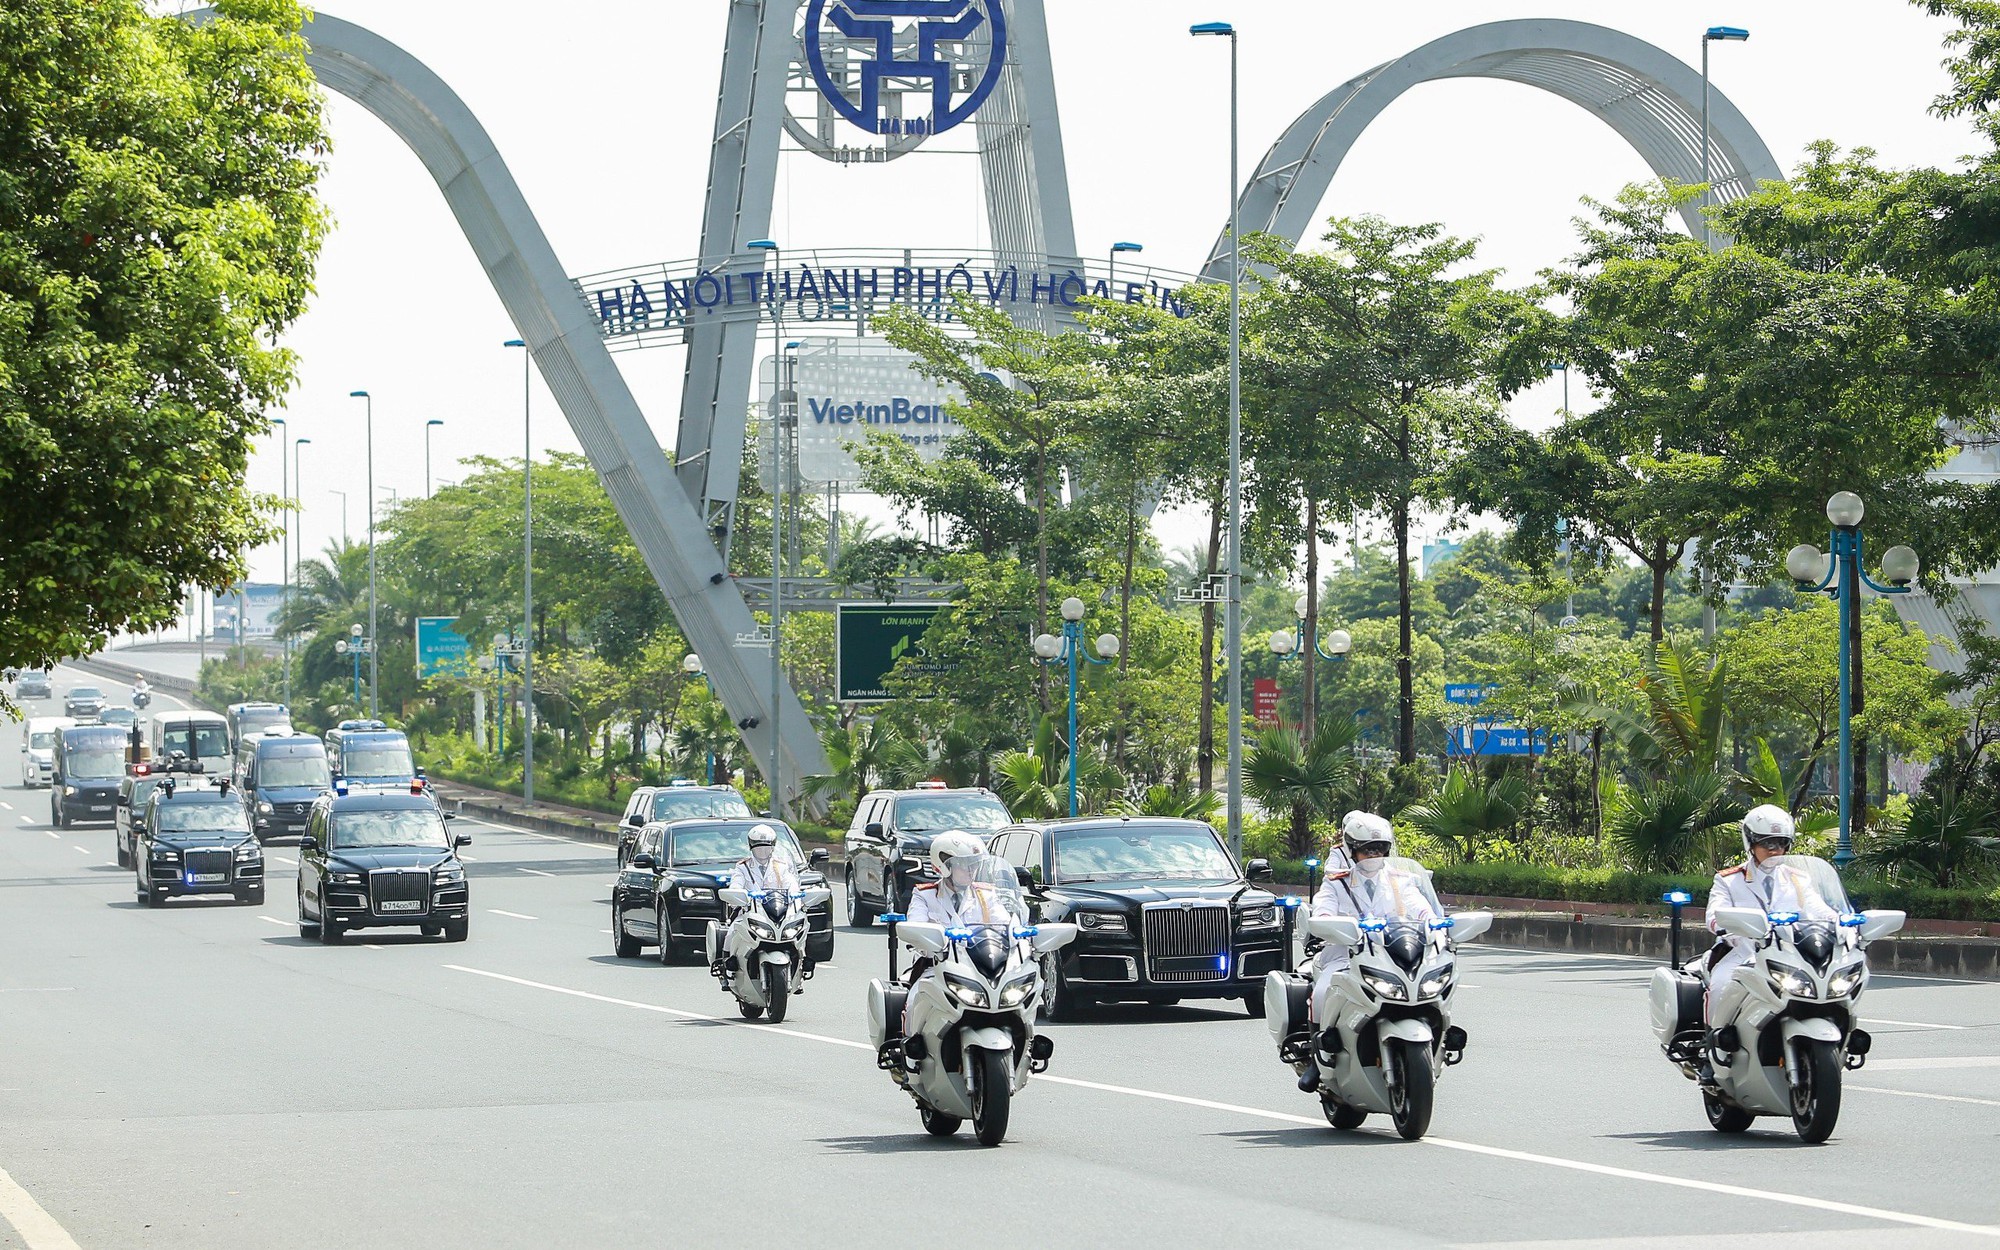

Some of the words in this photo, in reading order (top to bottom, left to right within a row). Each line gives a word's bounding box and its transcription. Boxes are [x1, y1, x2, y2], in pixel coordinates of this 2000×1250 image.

[598, 279, 654, 320] HÀ
[664, 270, 733, 314] NỘI
[740, 264, 878, 303] THÀNH
[893, 258, 973, 298] PHỐ
[984, 265, 1017, 306] VÌ
[808, 398, 958, 425] VietinBan
[923, 433, 939, 446] giá
[900, 617, 925, 627] MẠNH
[847, 688, 867, 697] NGÂN
[867, 688, 887, 697] HÀNG
